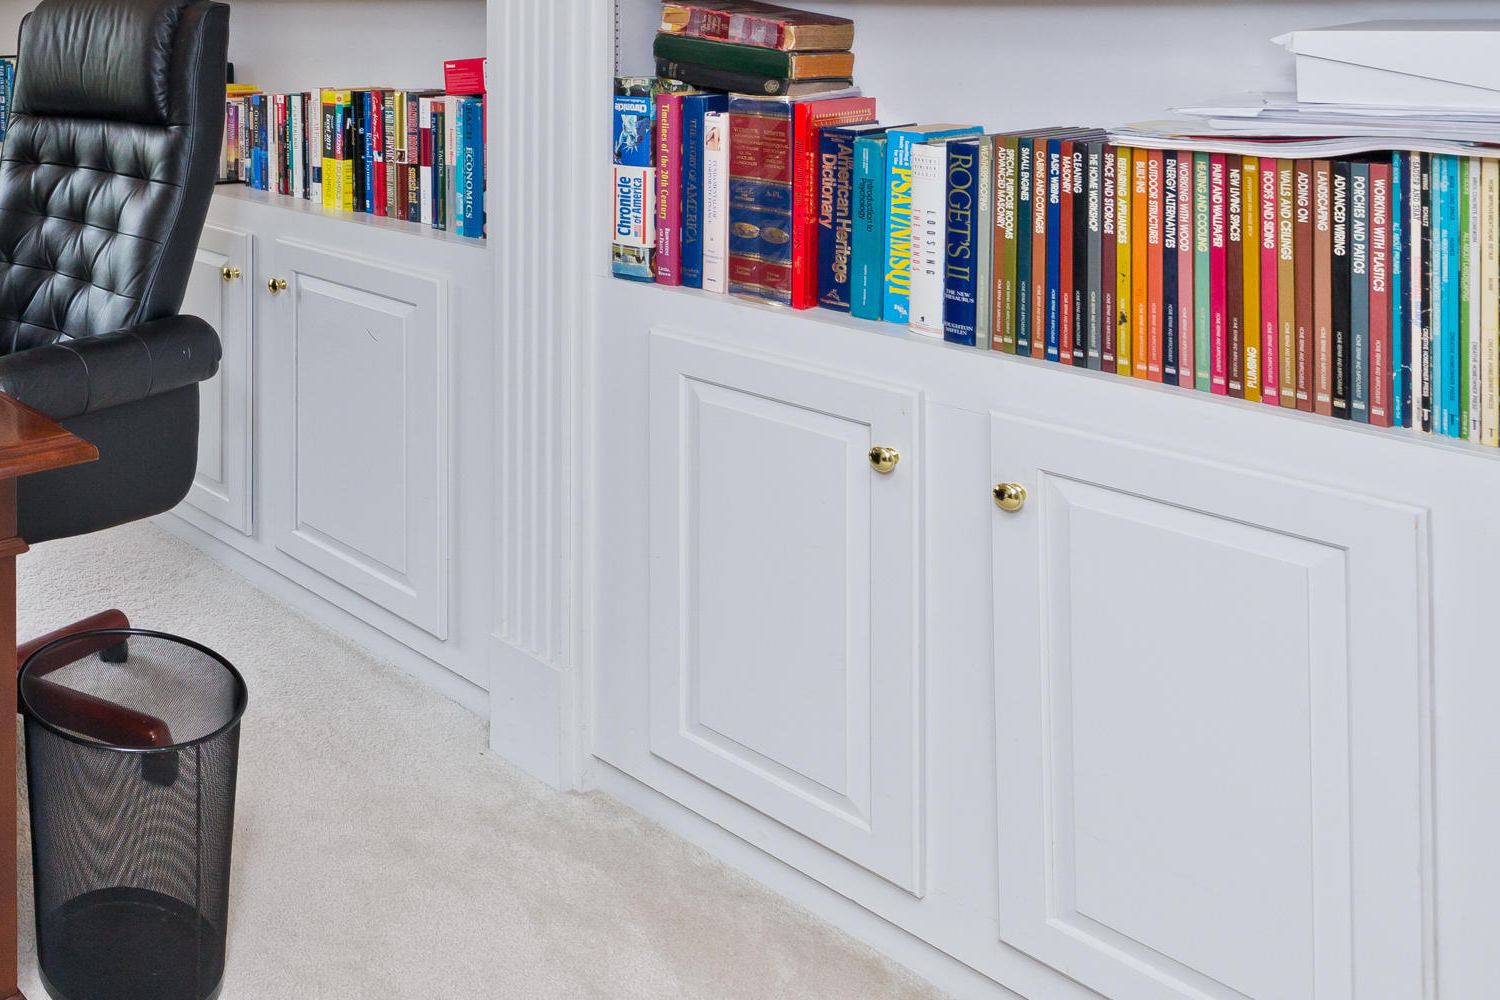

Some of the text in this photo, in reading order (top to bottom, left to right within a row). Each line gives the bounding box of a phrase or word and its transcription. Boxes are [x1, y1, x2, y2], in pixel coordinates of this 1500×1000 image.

[384, 95, 394, 107] THE
[385, 108, 394, 121] END
[385, 122, 394, 132] OF
[385, 135, 394, 163] PHYSICS
[1062, 156, 1072, 195] MASONRY
[1072, 152, 1083, 194] CLEANING
[408, 166, 420, 205] smash cut
[464, 146, 474, 219] ECONOMICS
[617, 175, 632, 237] Chronicle
[632, 176, 643, 225] of America
[818, 153, 838, 230] Dictionary
[832, 143, 854, 285] American Heritage
[858, 177, 868, 221] Psychology
[866, 178, 876, 233] Introduction to
[1104, 153, 1114, 236] SPACE AND STORAGE
[1148, 159, 1159, 246] OUTDOOR STRUCTURES
[1165, 158, 1176, 249] ENERGY ALTERNATIVES
[1179, 162, 1189, 253] WORKING WITH WOOD
[1211, 163, 1223, 249] PAINT AND WALLPAPER
[1229, 168, 1241, 243] NEW LIVING SPACES
[1262, 170, 1275, 250] ROOFS AND SIDING
[1297, 170, 1309, 224] ADDING ON
[1316, 170, 1328, 232] LANDSCAPING
[912, 208, 922, 272] THE BONDS
[925, 209, 937, 277] LOOSING
[947, 151, 973, 283] ROGET'S II
[1279, 169, 1292, 261] WALLS AND CEILINGS
[1333, 173, 1346, 257] ADVANCED WIRING
[1352, 175, 1365, 276] PORCHES AND PATIOS
[1372, 178, 1385, 293] WORKING WITH PLASTICS
[946, 288, 971, 298] THE NEW
[946, 326, 968, 336] MIFFLIN
[1247, 346, 1258, 390] PLUMBING
